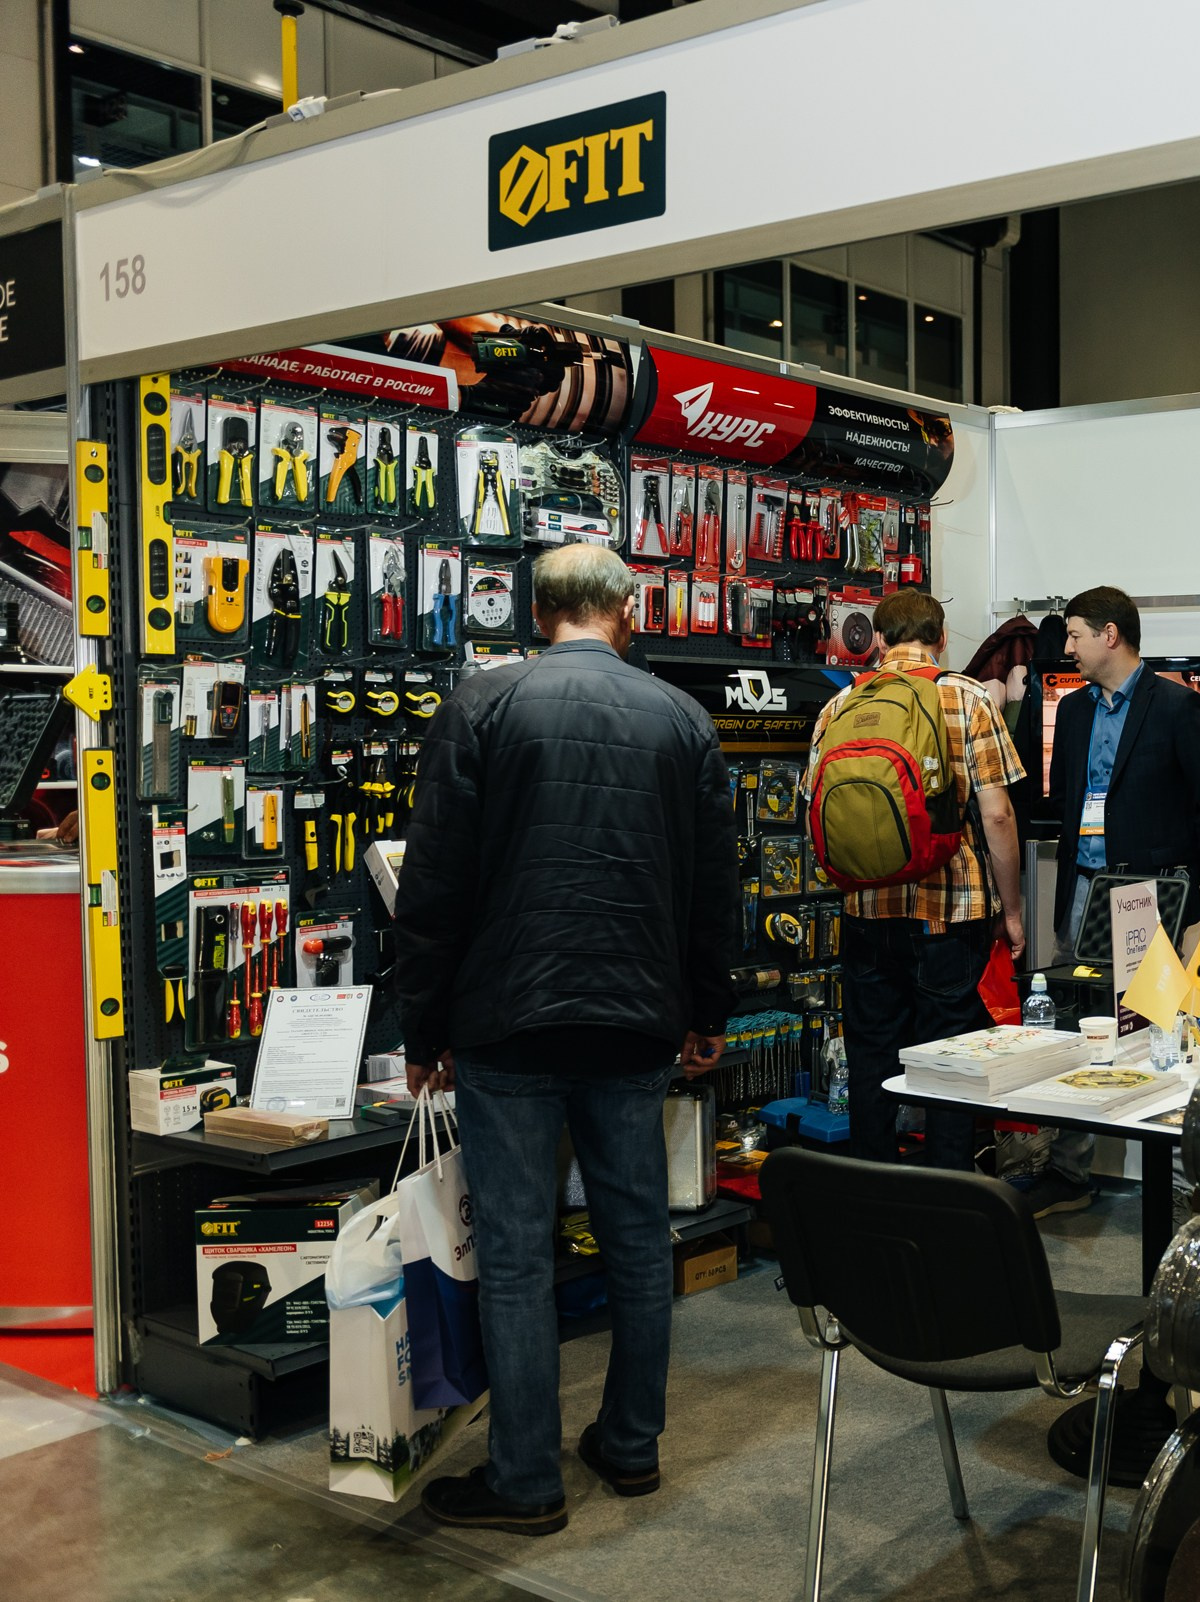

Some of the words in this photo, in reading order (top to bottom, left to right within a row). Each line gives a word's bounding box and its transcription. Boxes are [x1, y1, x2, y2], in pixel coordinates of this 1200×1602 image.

[545, 119, 654, 213] FIT
[99, 254, 147, 302] 158
[303, 363, 371, 384] РАБОТАЕТ
[372, 376, 384, 388] В
[383, 379, 435, 397] РОССИИ
[828, 405, 911, 432] ЭФФЕКТИВНОСТЬ!
[688, 411, 777, 448] КУРС
[845, 431, 911, 453] НАДЕЖНОСТЬ!
[853, 456, 906, 474] КАЧЕСТВО!
[712, 719, 744, 730] ARGIN
[745, 719, 760, 730] OF
[763, 719, 806, 731] SAFETY
[1116, 896, 1153, 914] Участник
[1125, 927, 1147, 946] iPRO
[1126, 944, 1147, 956] OneTeam
[212, 1221, 239, 1234] FIT
[204, 1246, 226, 1254] ЩИТОК
[226, 1246, 257, 1254] СВАРЩИКА
